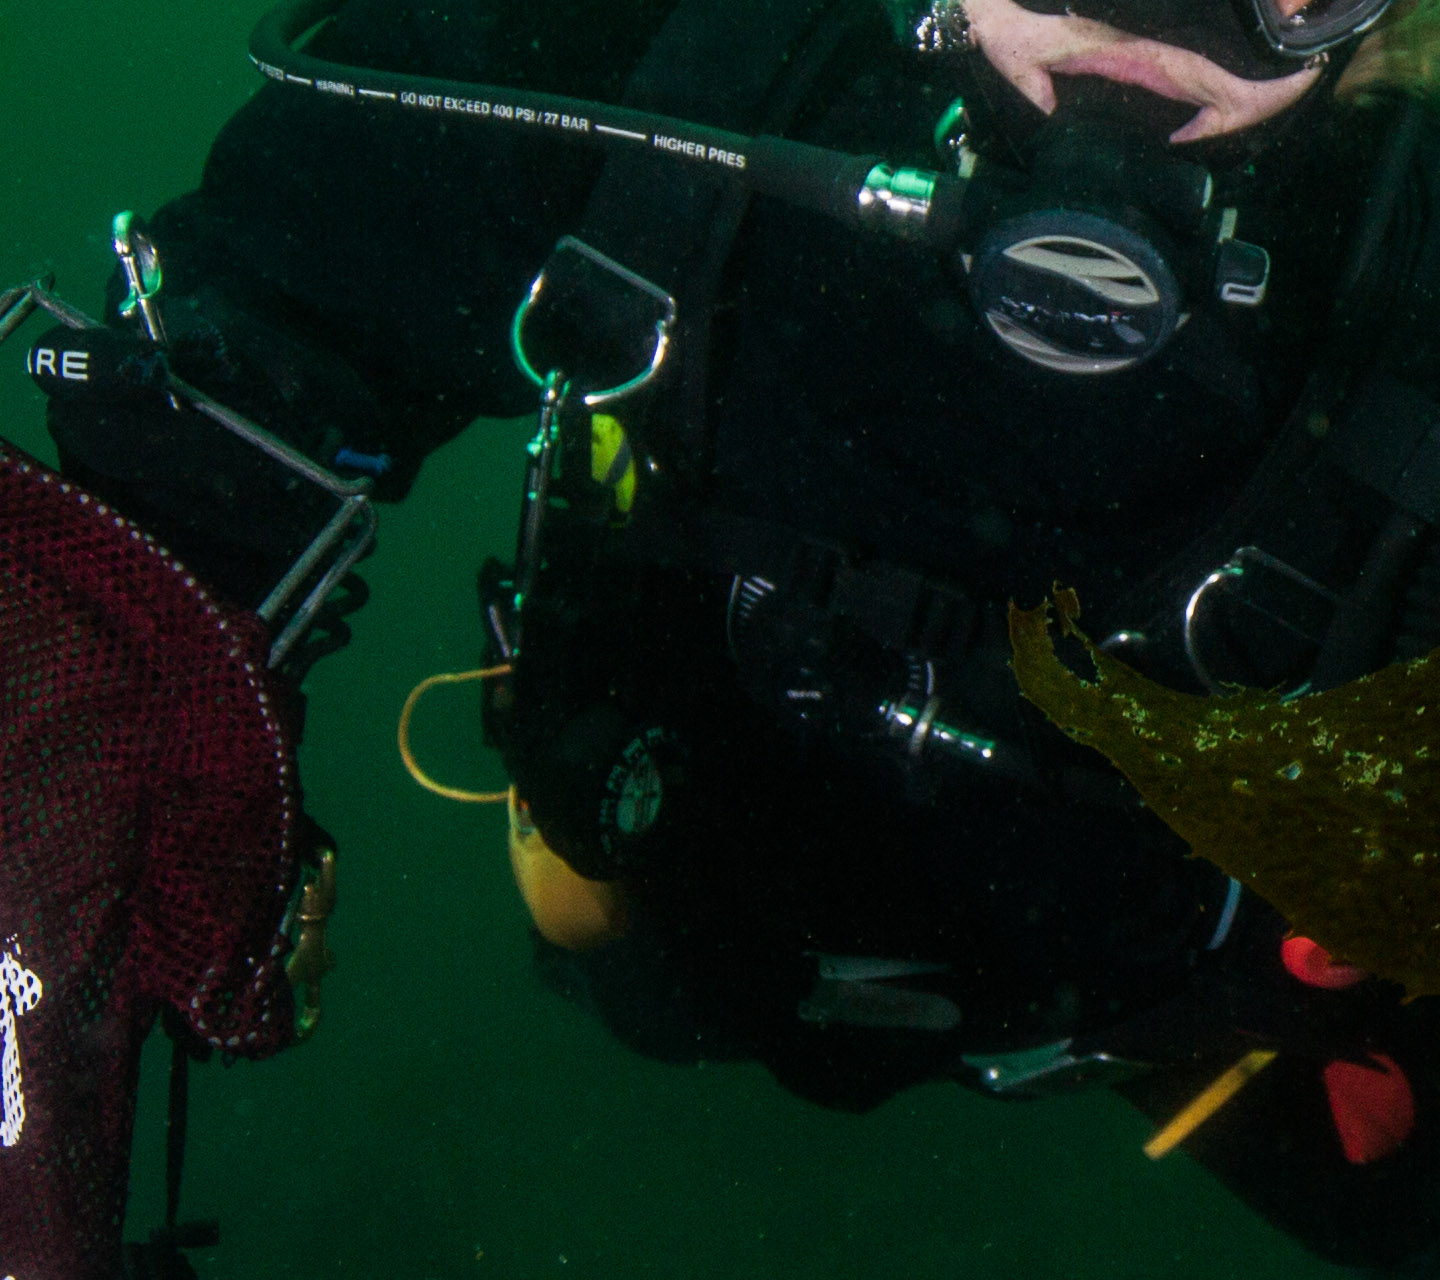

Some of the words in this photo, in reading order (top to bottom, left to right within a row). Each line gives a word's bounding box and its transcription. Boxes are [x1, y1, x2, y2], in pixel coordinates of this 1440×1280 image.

[418, 94, 442, 109] NOT
[443, 96, 491, 115] EXCEED
[491, 103, 514, 119] 400
[515, 106, 536, 122] PSI
[544, 111, 560, 126] 27
[561, 114, 589, 132] BAR
[653, 133, 706, 158] HIGHER
[708, 146, 746, 169] PRES
[27, 347, 89, 380] RE
